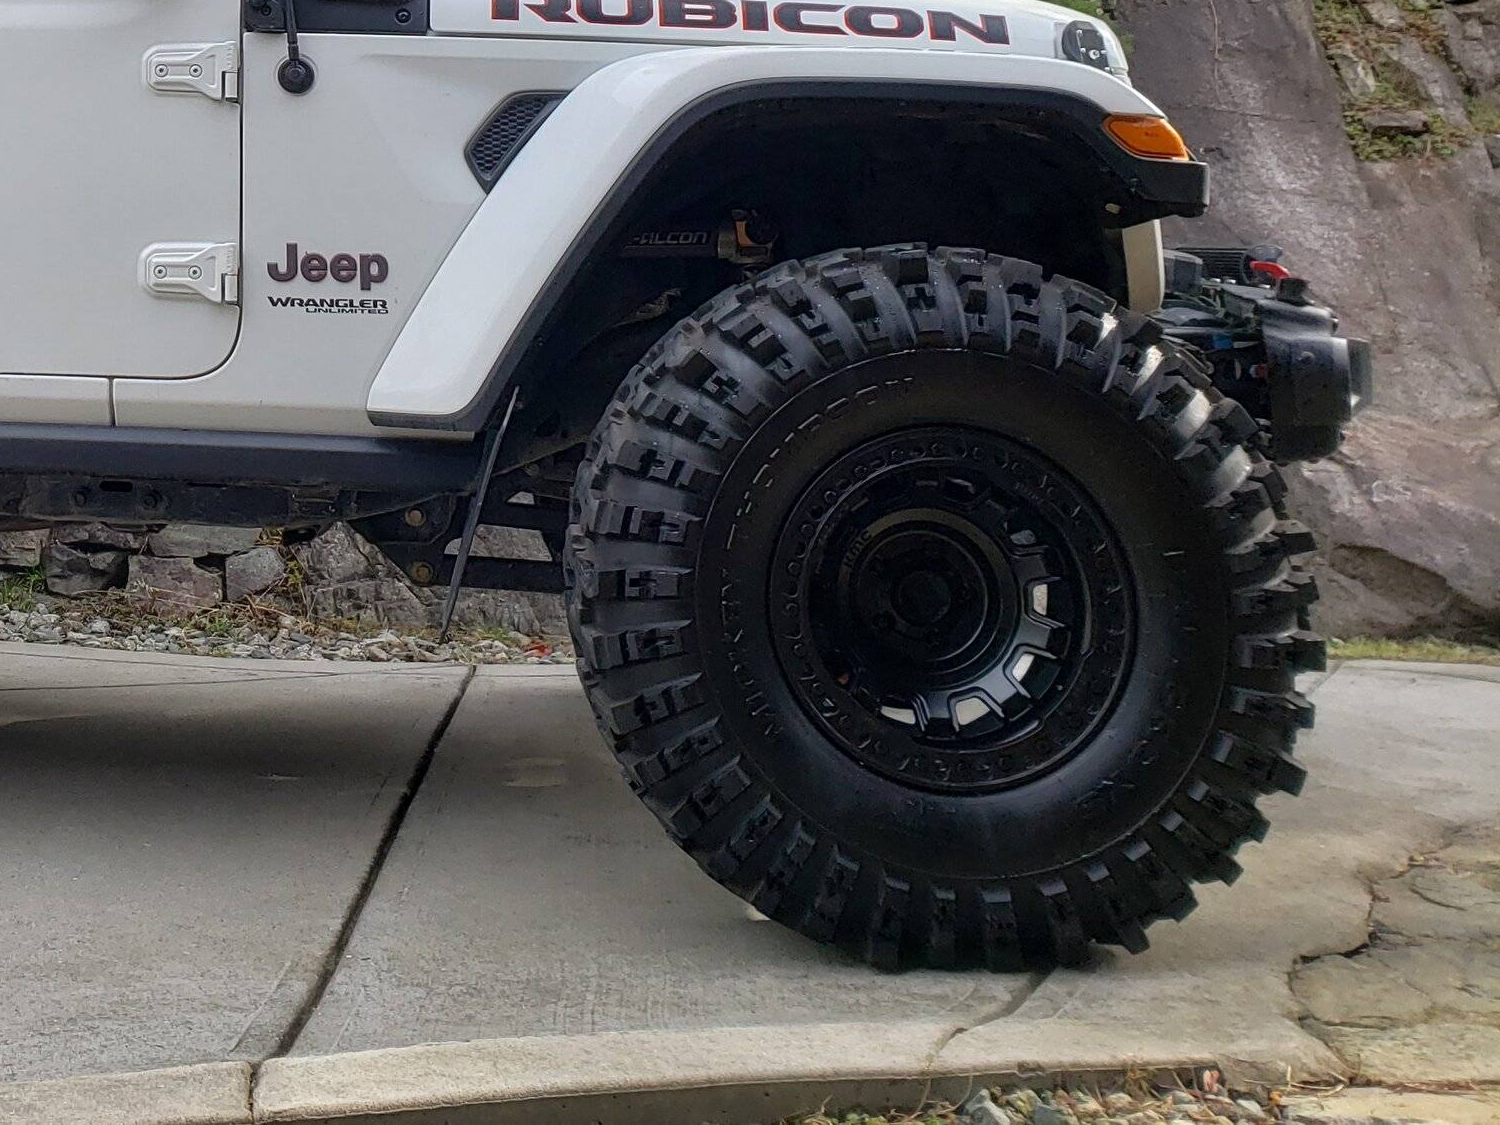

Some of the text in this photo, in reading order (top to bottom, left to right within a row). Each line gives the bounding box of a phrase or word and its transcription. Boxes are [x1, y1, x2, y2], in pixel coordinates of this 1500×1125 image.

[266, 242, 389, 291] Jeep
[267, 296, 388, 309] WRANGLER
[306, 307, 389, 315] UNLIMITED
